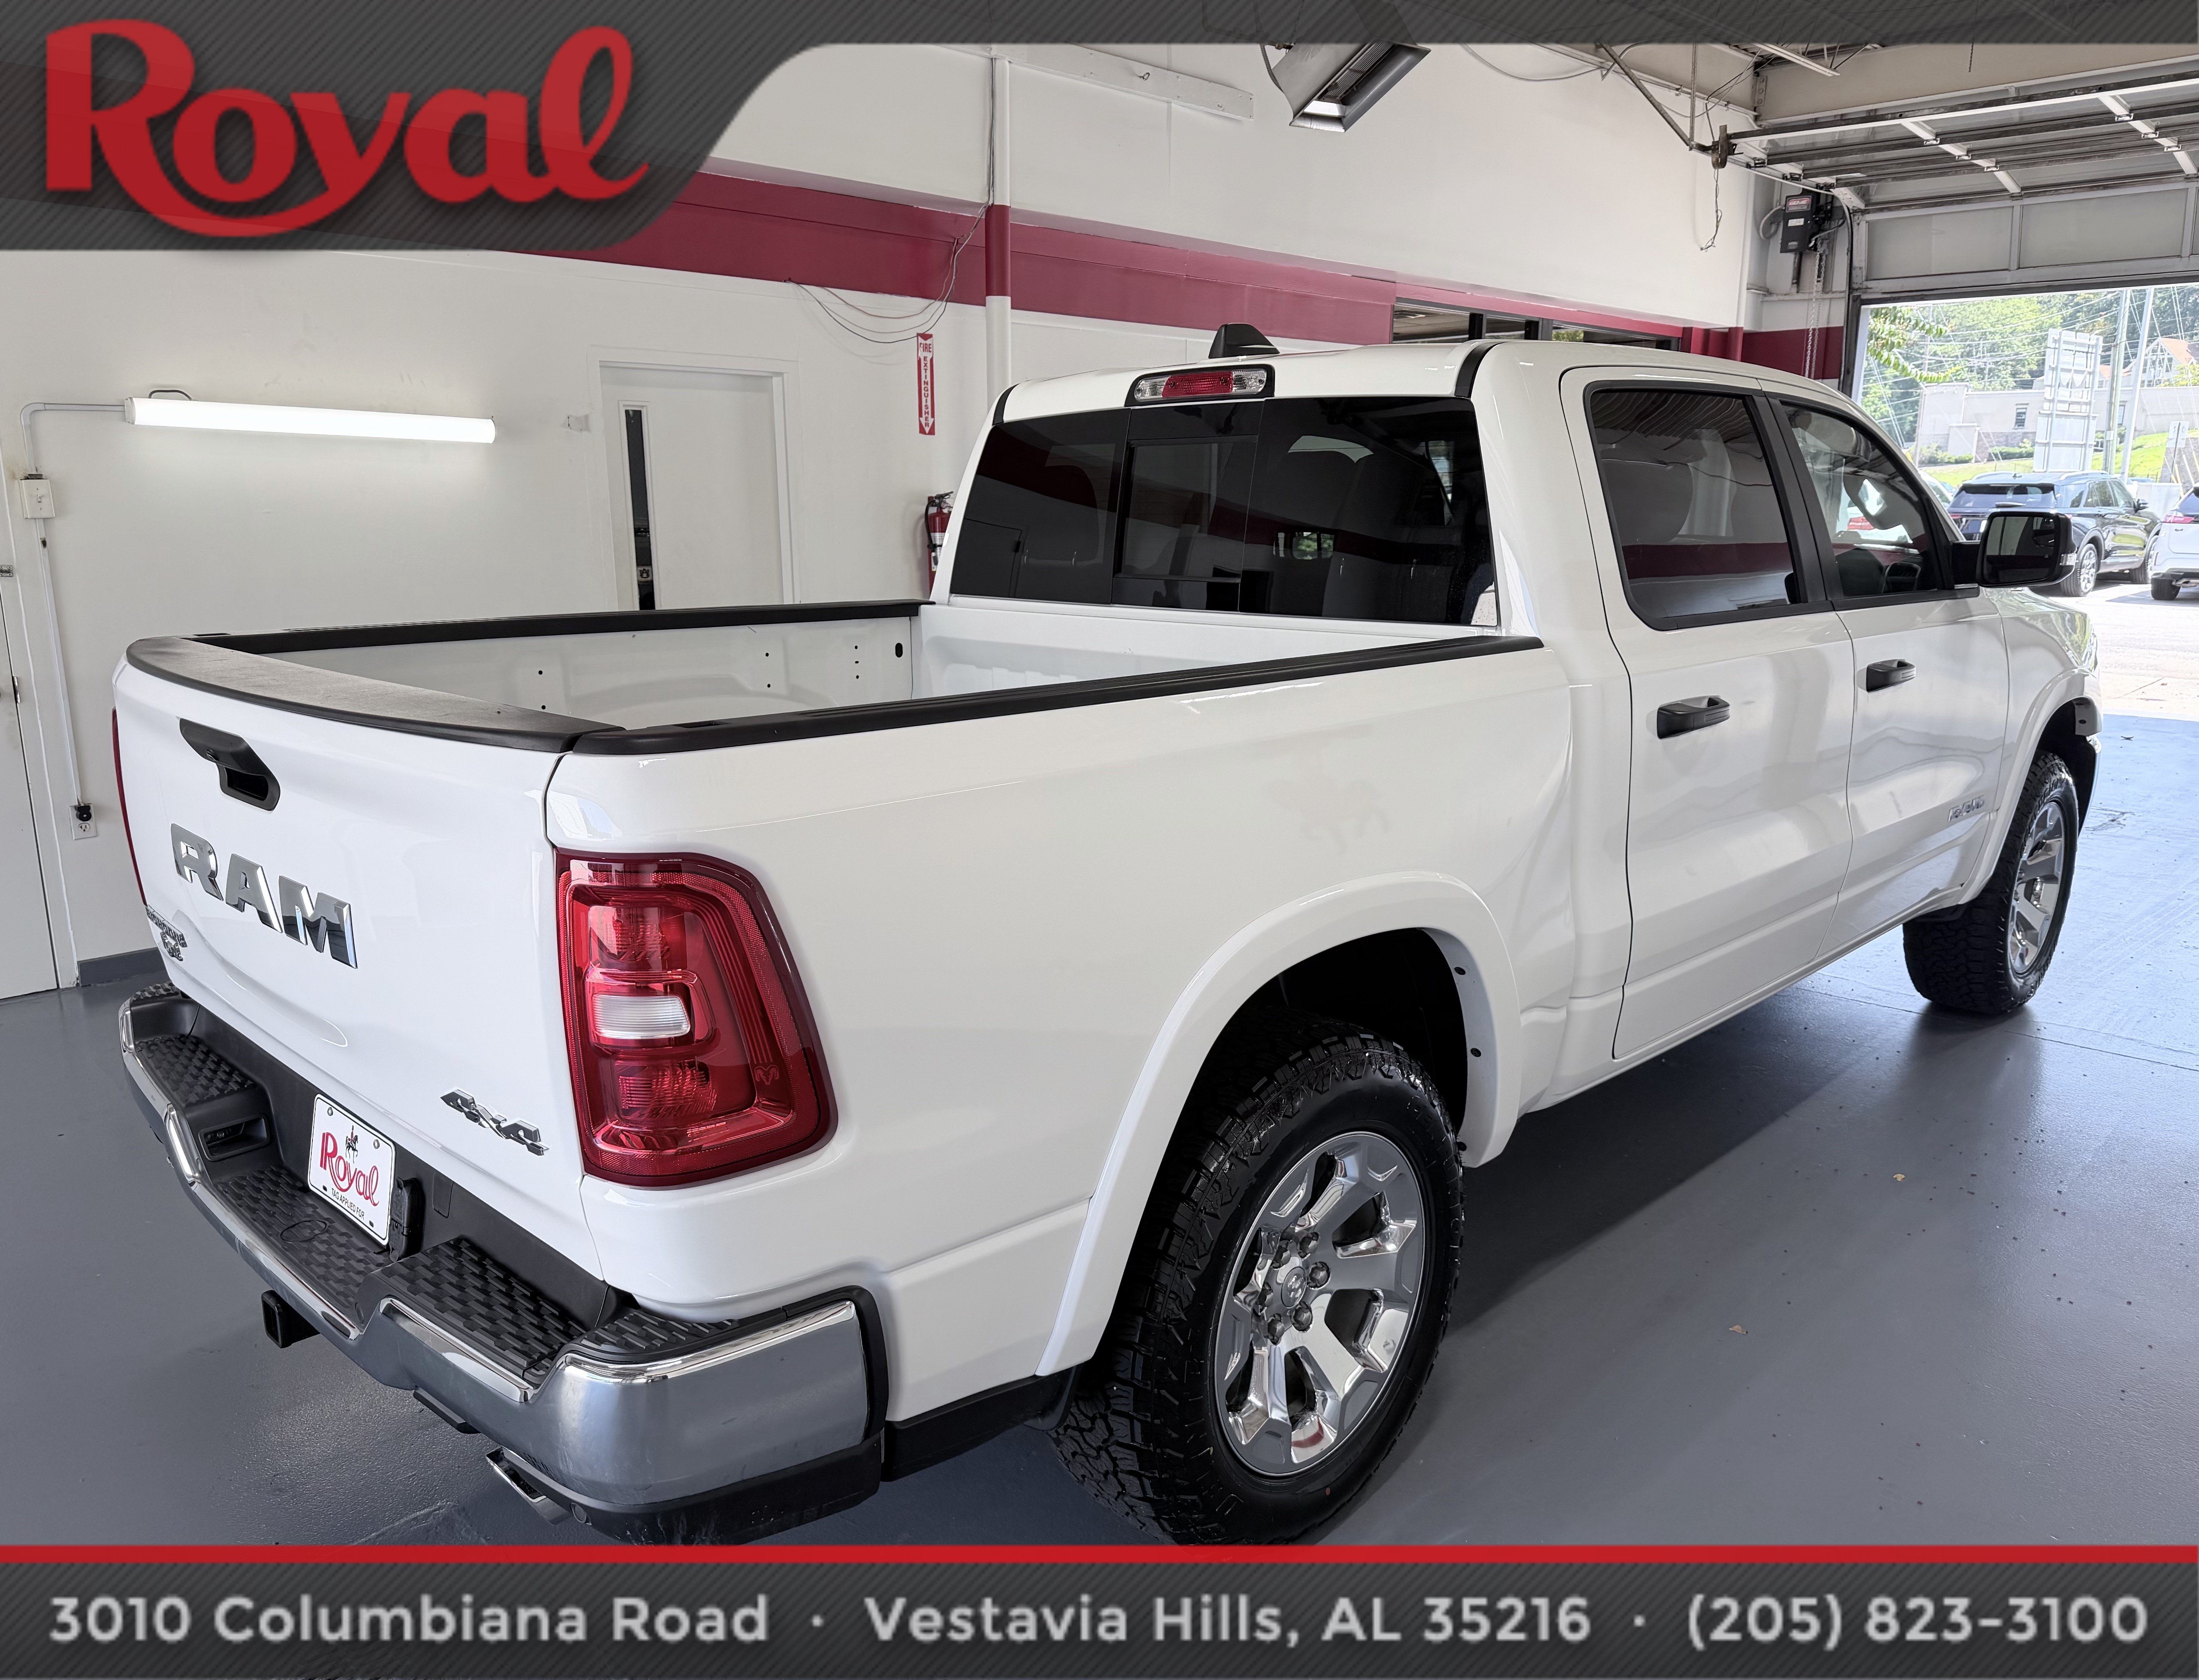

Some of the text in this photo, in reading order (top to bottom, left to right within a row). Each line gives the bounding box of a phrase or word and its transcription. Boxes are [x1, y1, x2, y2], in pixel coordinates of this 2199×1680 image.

[919, 342, 932, 353] FIRE
[171, 823, 358, 969] RAM
[320, 1132, 379, 1206] Royal
[340, 1194, 356, 1213] APPLIED
[356, 1207, 365, 1220] FOR
